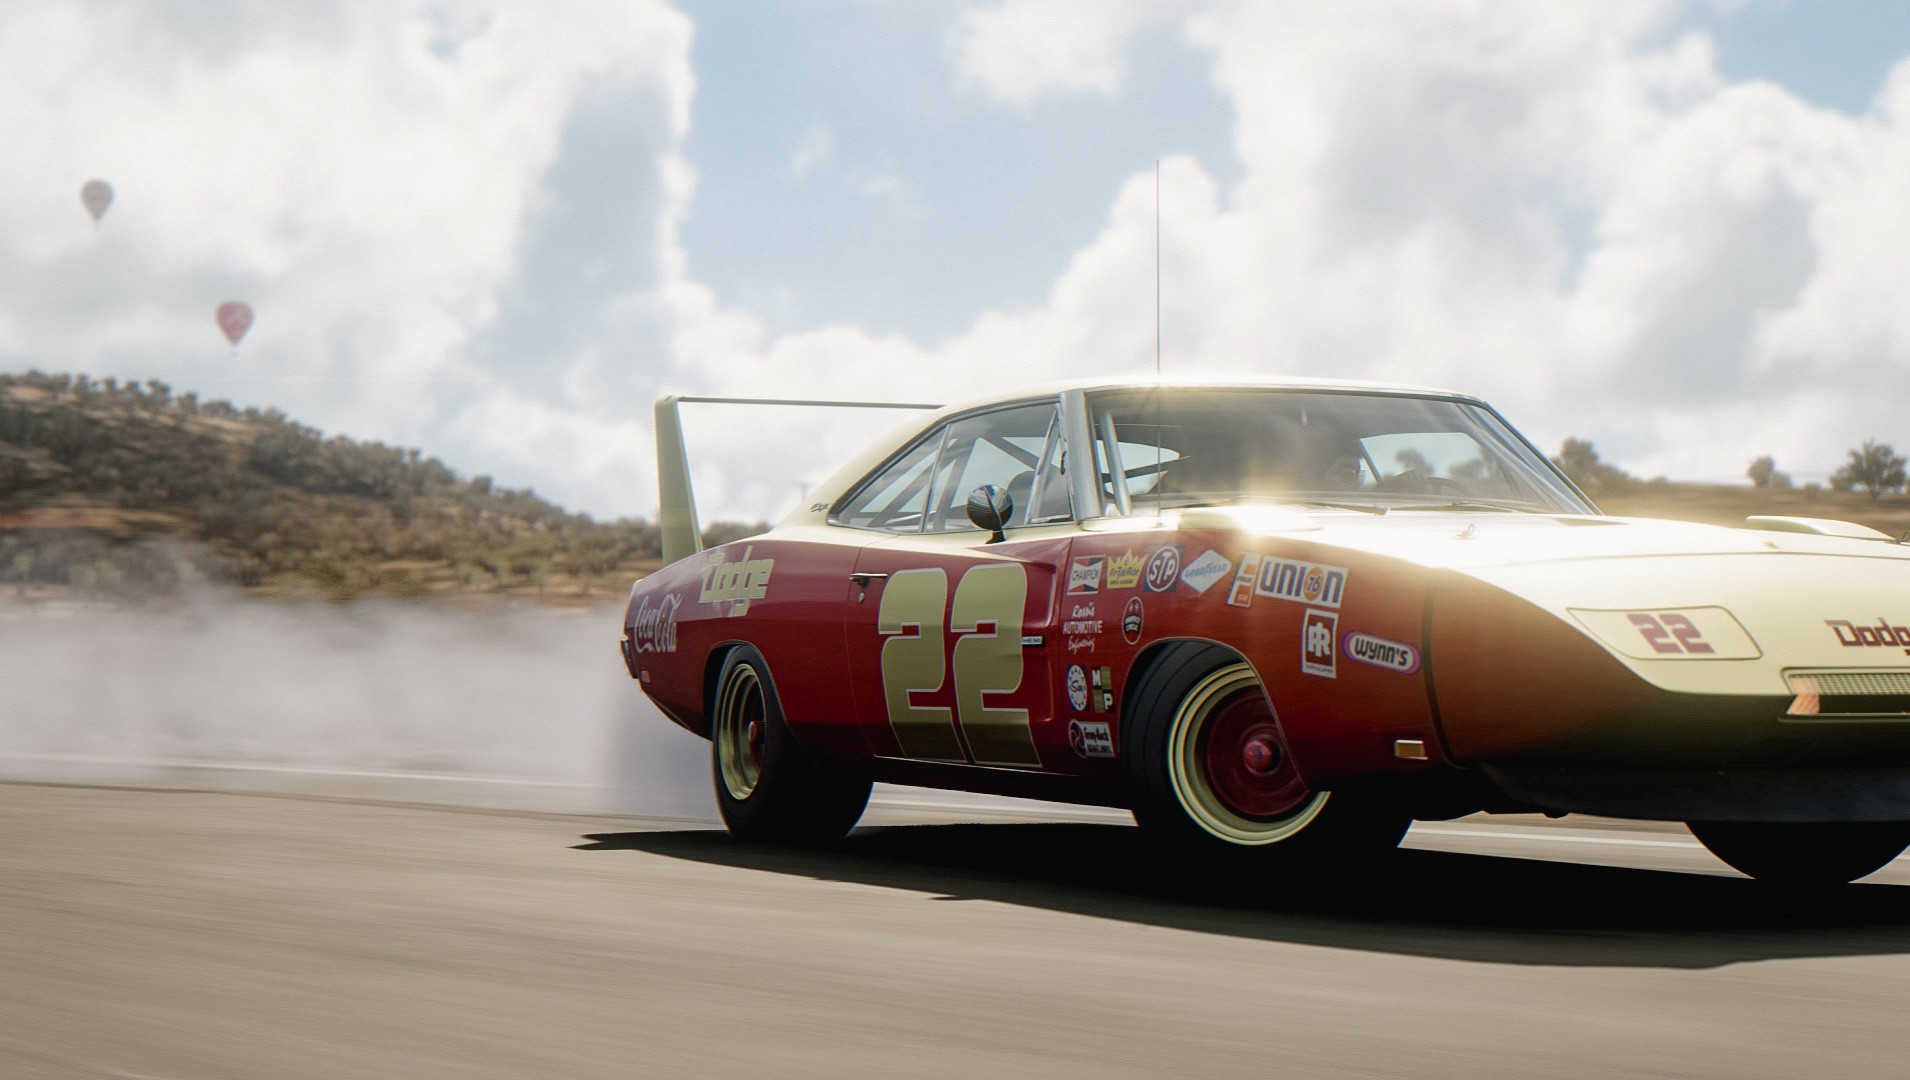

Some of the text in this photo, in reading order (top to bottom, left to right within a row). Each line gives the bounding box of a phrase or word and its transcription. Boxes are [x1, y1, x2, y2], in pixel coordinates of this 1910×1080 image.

[699, 545, 774, 616] Dodge
[1150, 551, 1175, 584] STP
[1306, 573, 1320, 593] 76
[1063, 620, 1103, 634] AUTOMOTIVE
[1626, 613, 1716, 654] 22
[878, 562, 1043, 768] 22
